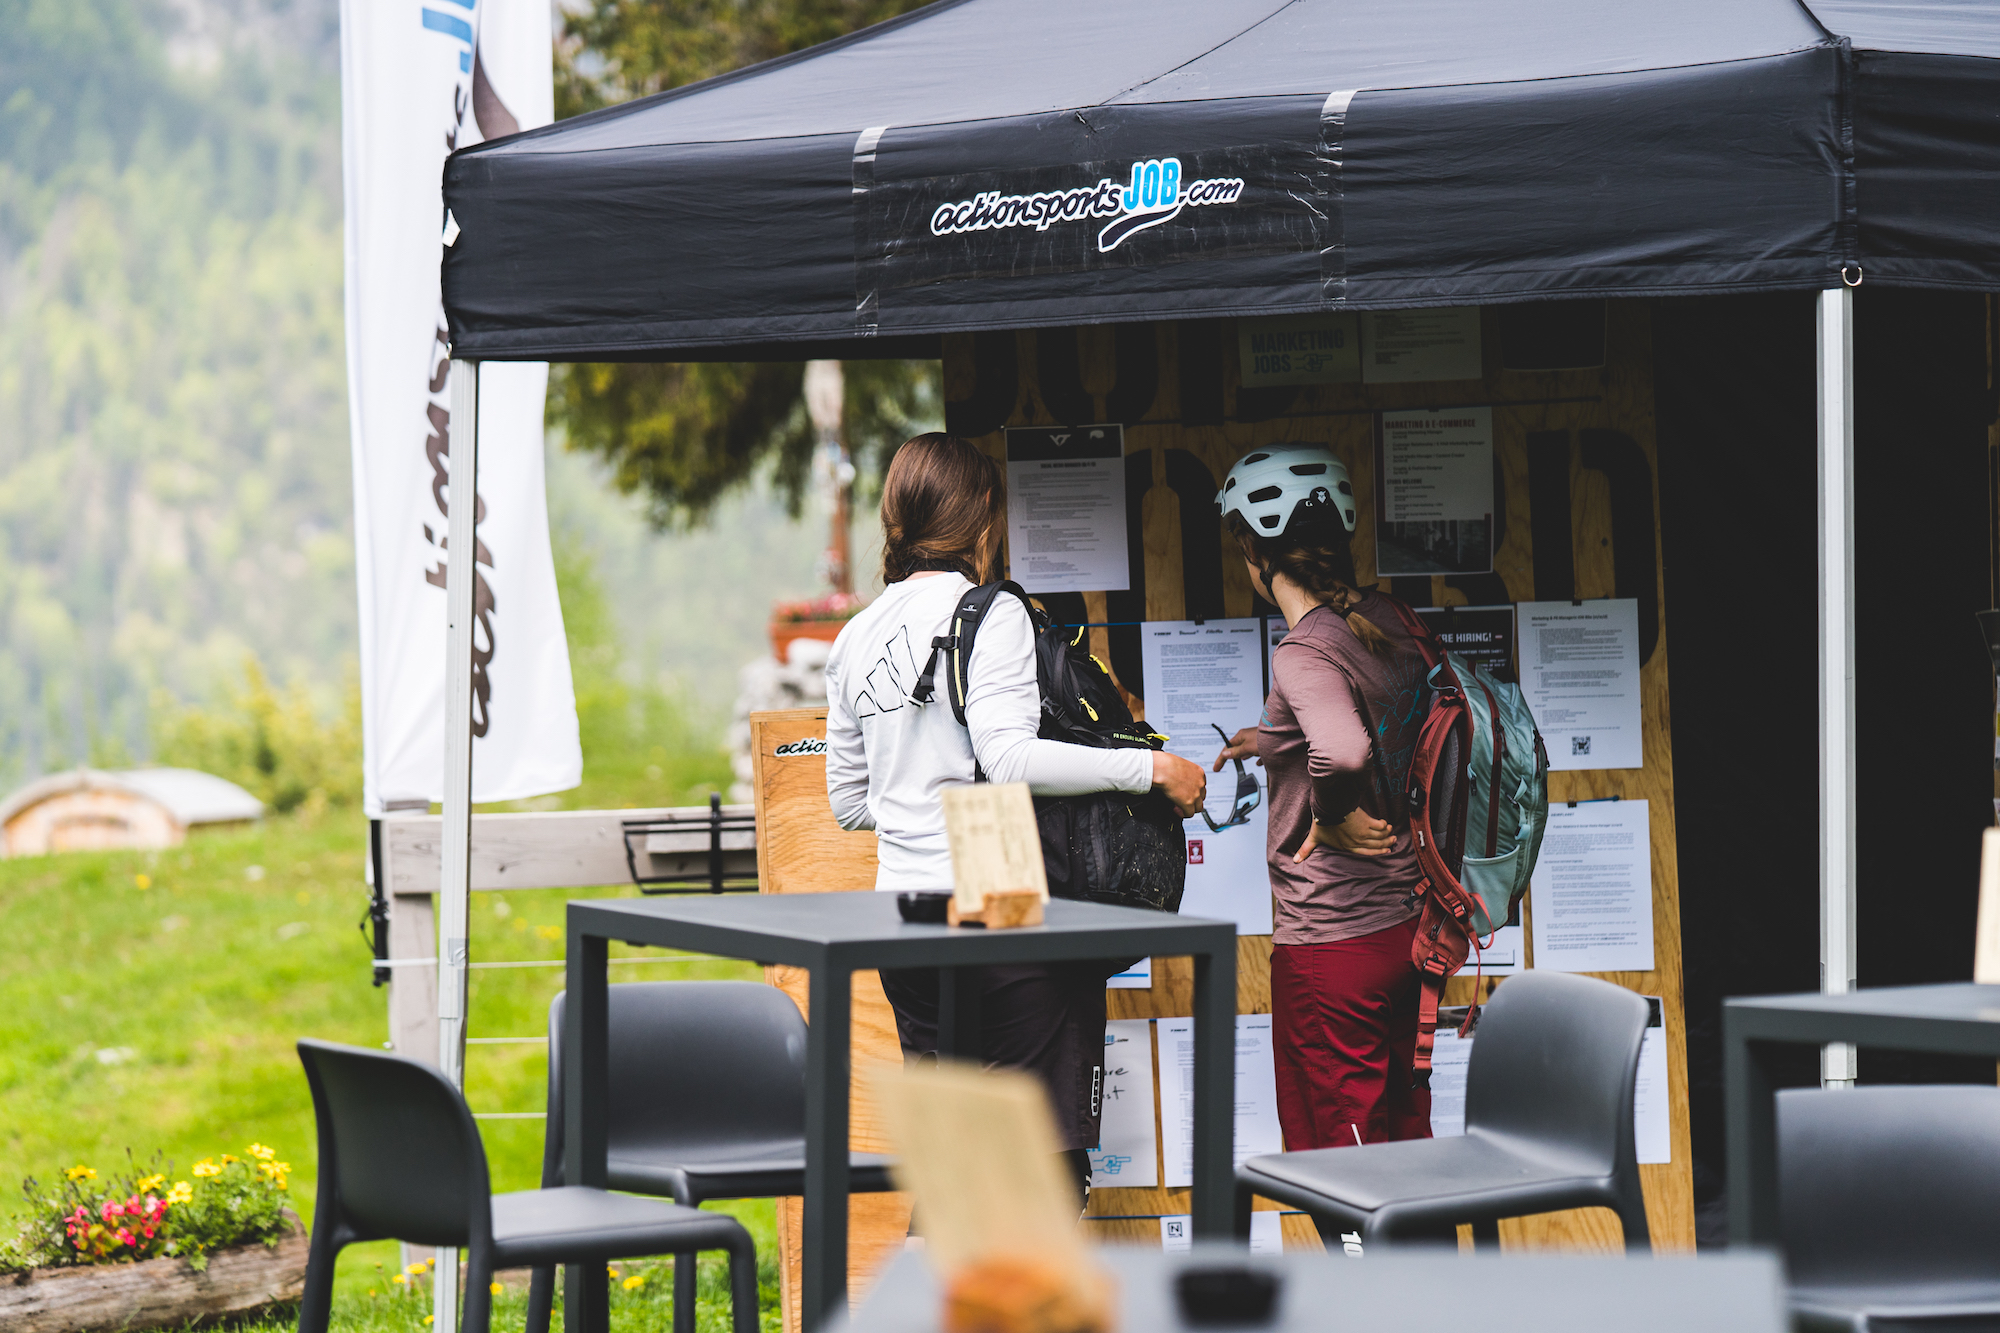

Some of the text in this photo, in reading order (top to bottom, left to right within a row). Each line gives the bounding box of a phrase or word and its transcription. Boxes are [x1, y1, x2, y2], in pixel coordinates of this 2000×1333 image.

[931, 158, 1245, 237] actionsportsJOB.com
[1251, 328, 1344, 353] MARKETING
[1252, 354, 1292, 374] JOBS
[1385, 420, 1424, 429] MARKETING
[1432, 418, 1476, 428] E-COMMERCE
[1456, 632, 1492, 642] HIRING!
